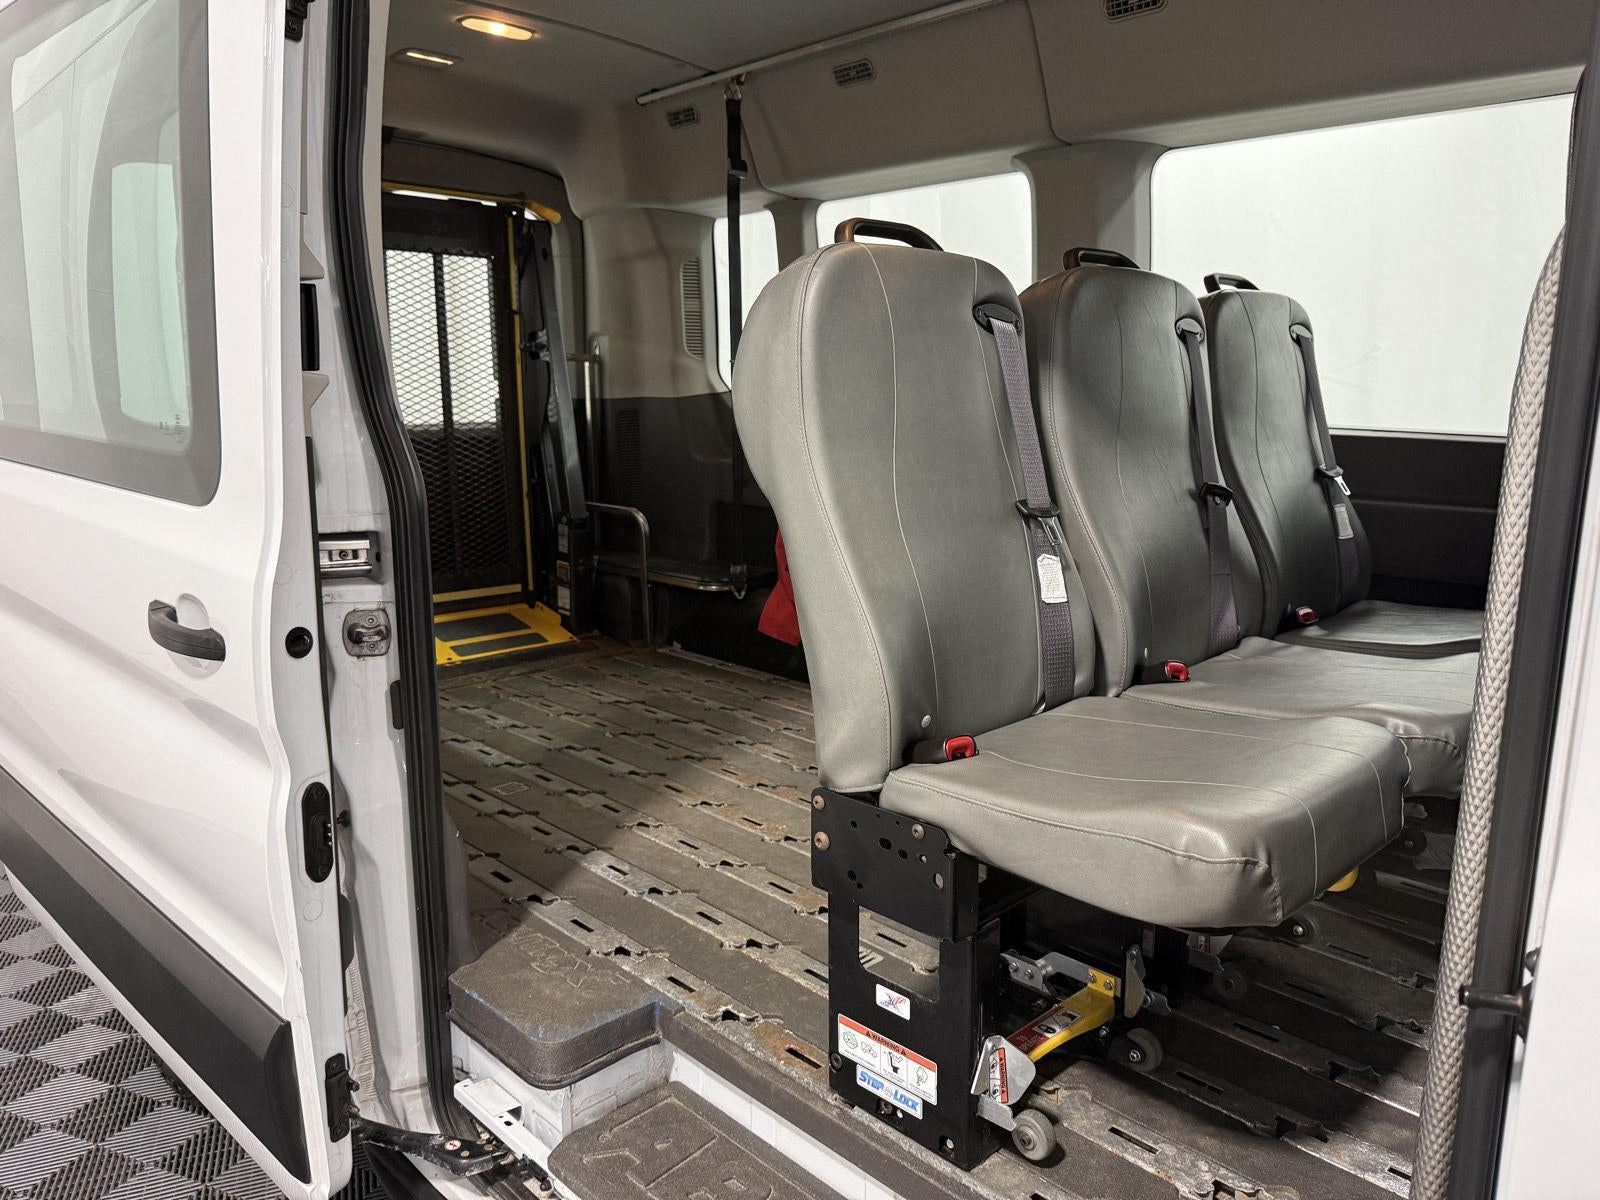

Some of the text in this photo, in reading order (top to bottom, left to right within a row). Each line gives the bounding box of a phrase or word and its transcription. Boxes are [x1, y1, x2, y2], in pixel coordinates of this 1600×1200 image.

[871, 1032, 900, 1053] WARNING
[859, 1070, 885, 1091] STEP
[893, 1089, 920, 1112] LOCK
